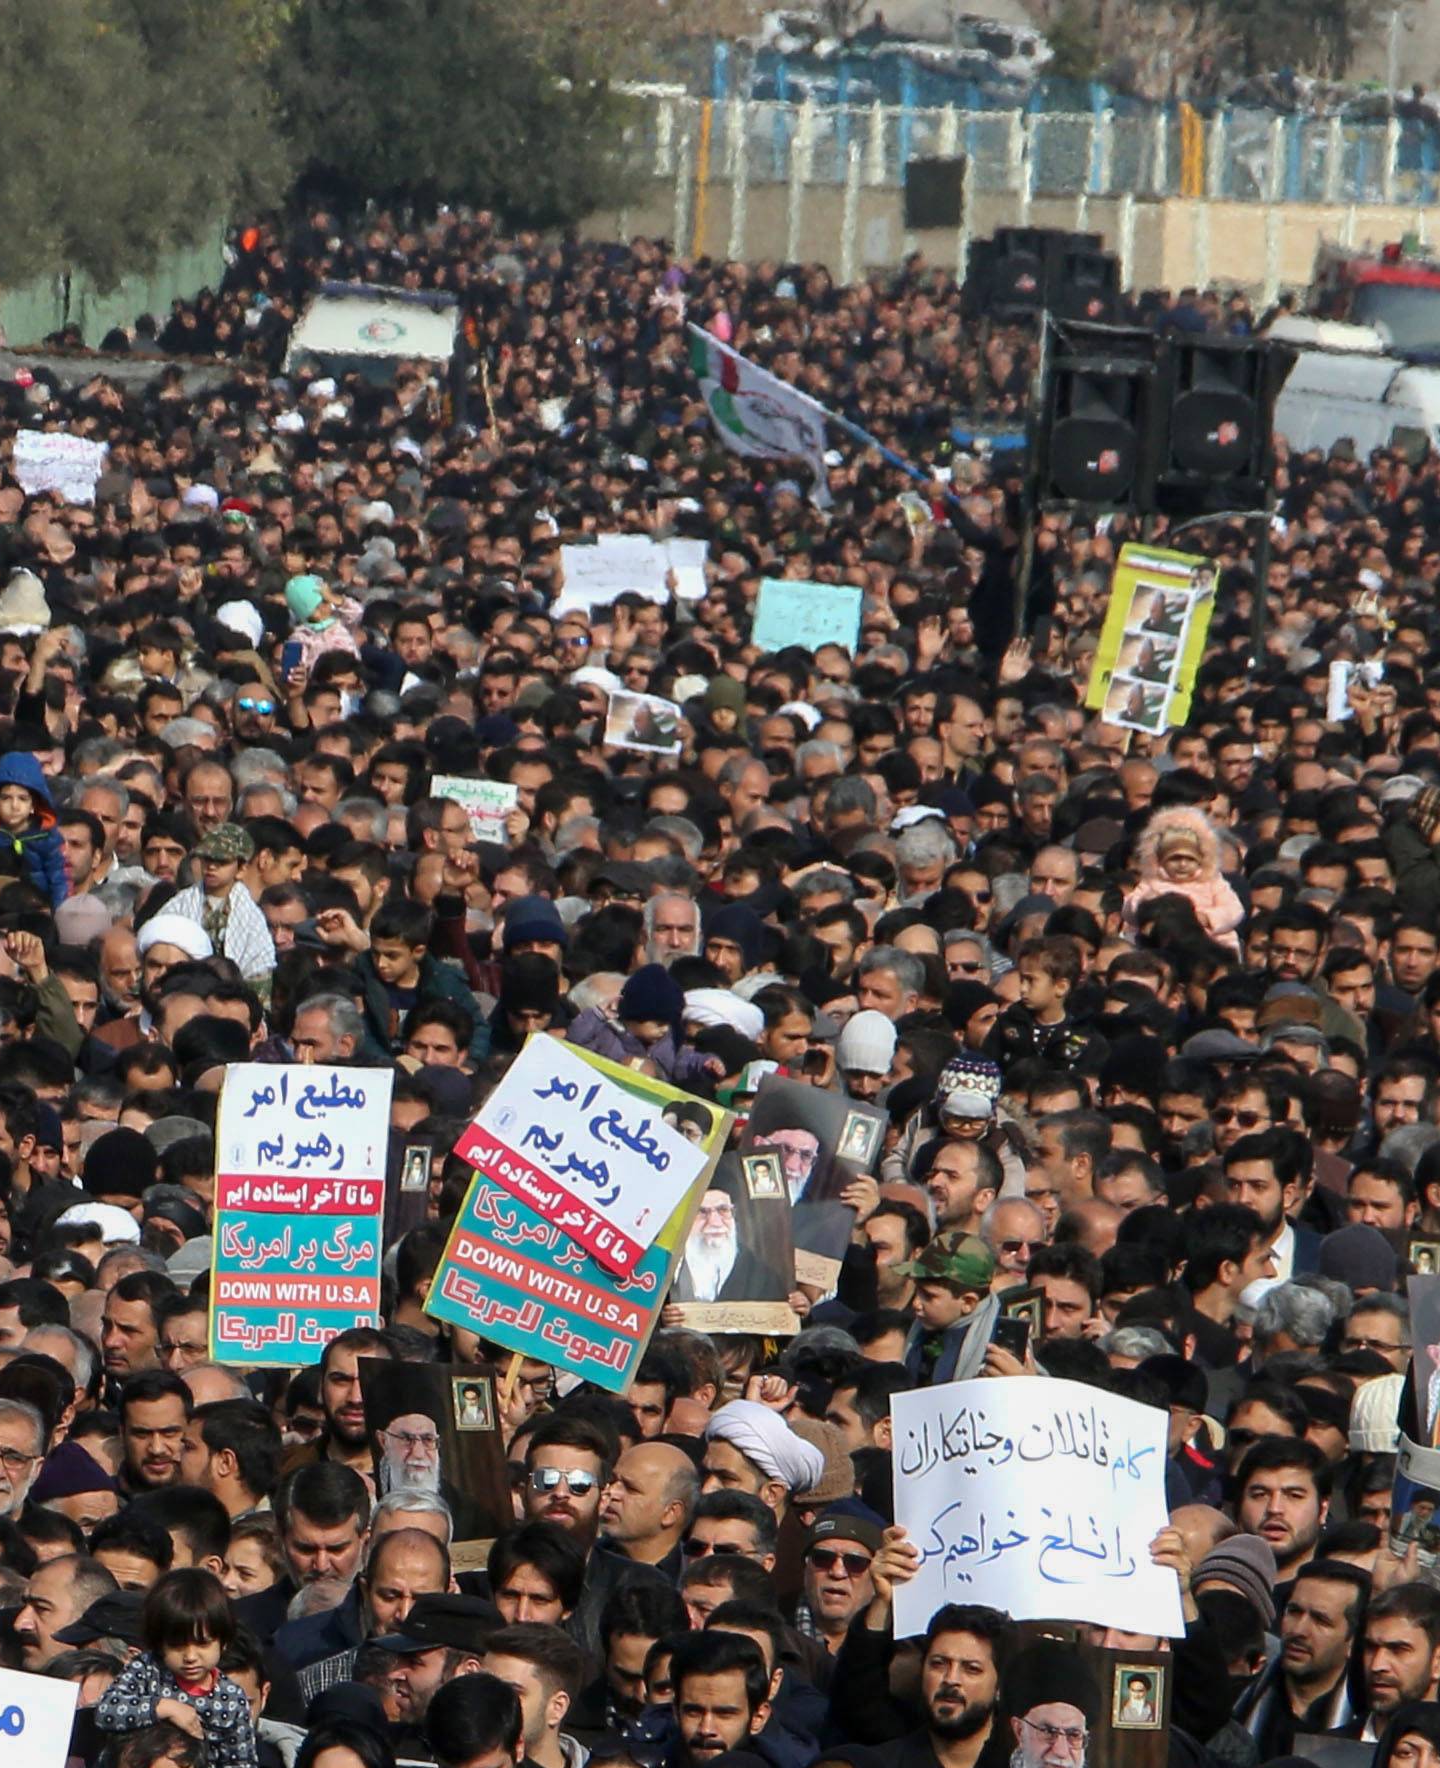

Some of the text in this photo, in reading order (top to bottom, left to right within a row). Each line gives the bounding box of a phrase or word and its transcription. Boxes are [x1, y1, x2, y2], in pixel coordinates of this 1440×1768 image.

[243, 1072, 366, 1119] مطیع امر
[533, 1075, 670, 1172] مطیع امر
[257, 1132, 345, 1170] رهبریم
[520, 1123, 621, 1207] رهبریم
[900, 1406, 1155, 1490] کام قاتلان و جنایتکاران
[918, 1502, 1136, 1589] را تلخ خواهیم کر
